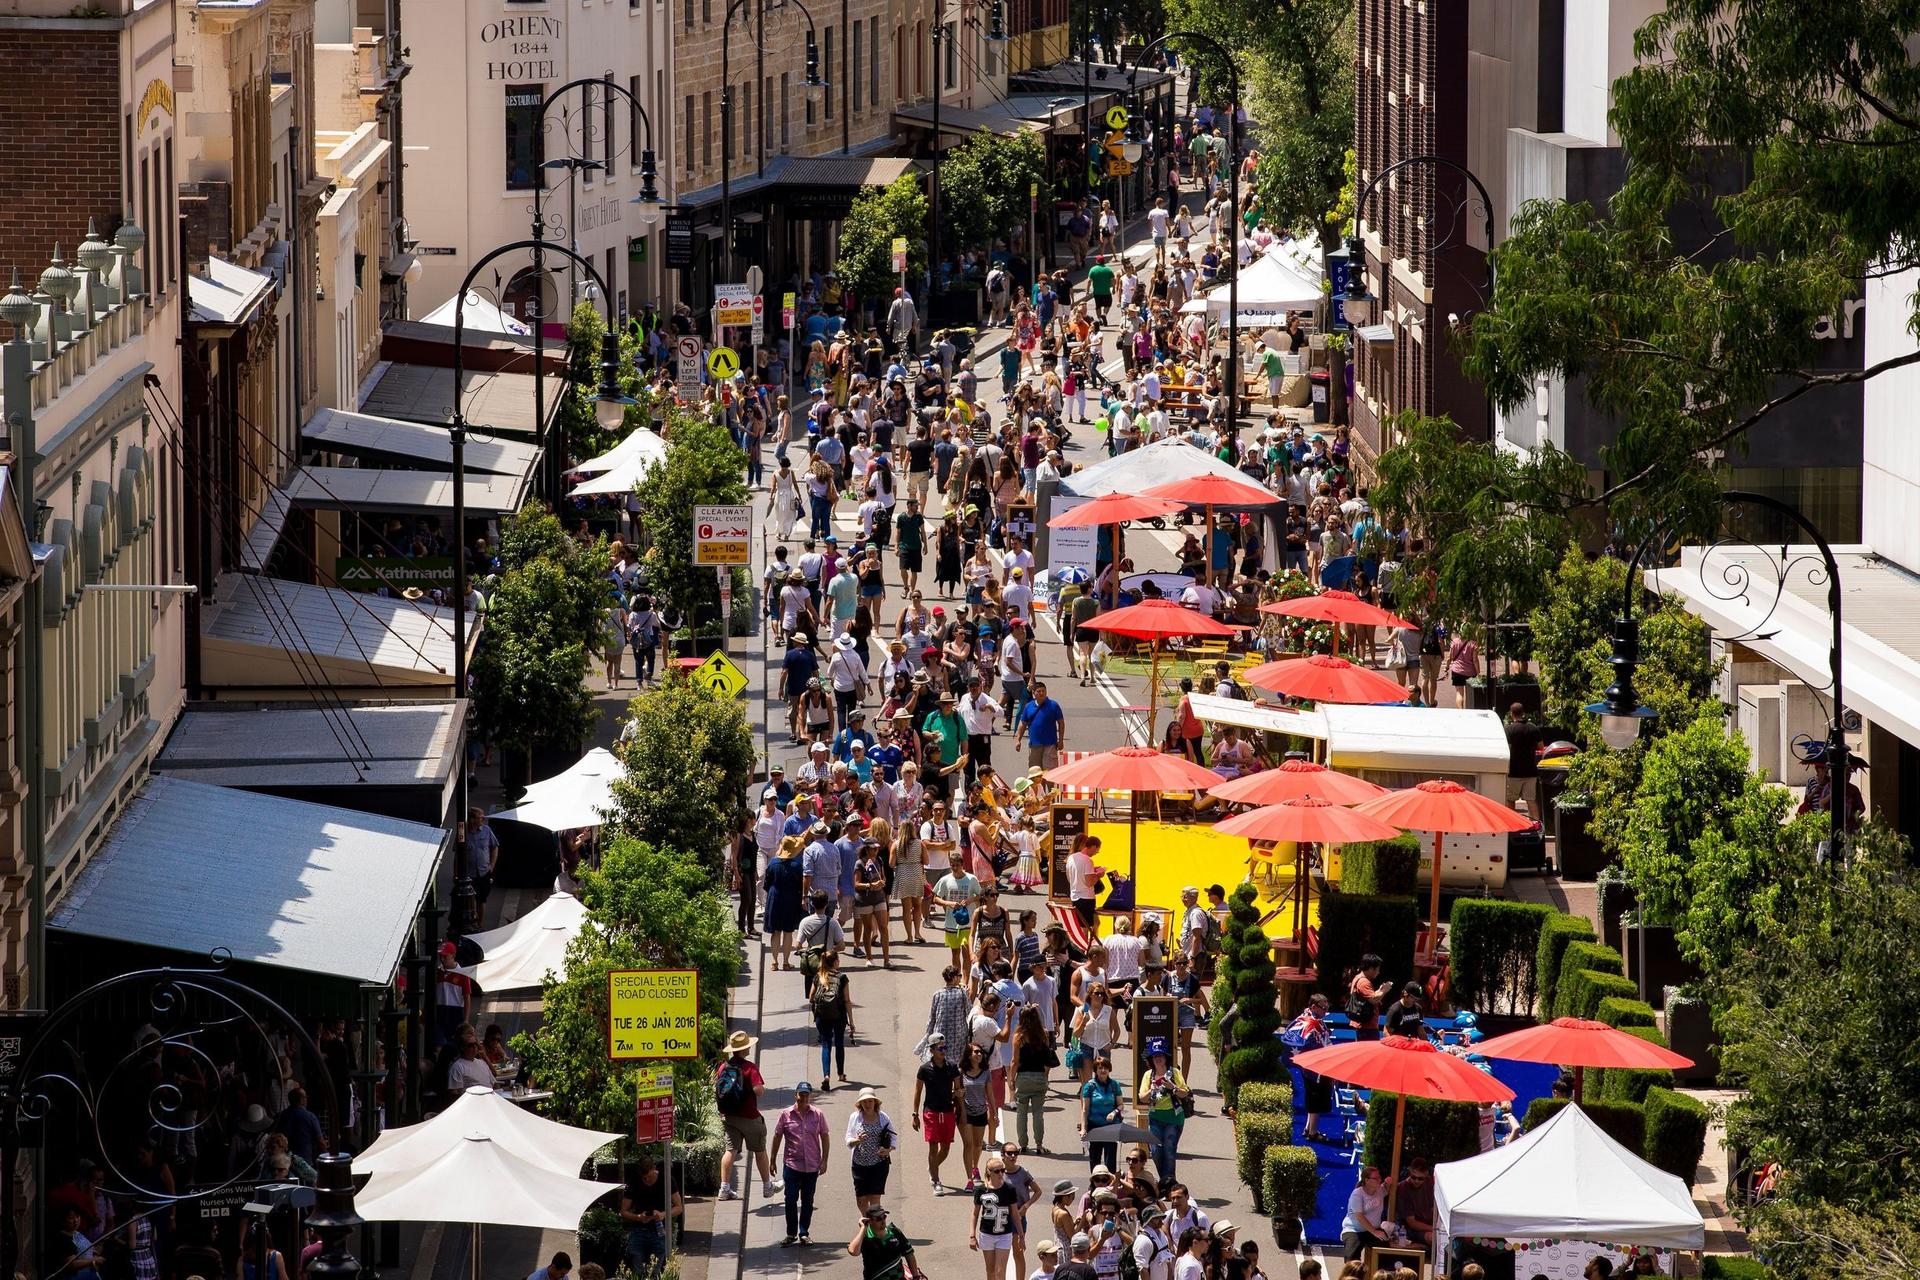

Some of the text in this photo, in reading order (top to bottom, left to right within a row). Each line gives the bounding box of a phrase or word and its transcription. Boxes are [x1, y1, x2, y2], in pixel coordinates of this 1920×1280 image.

[481, 16, 562, 43] ORIENT
[511, 42, 548, 54] 1844
[486, 60, 559, 80] HOTEL
[506, 94, 542, 107] RESTAURANT
[1114, 162, 1128, 170] 25
[578, 196, 622, 233] ORIENT HOTEL
[702, 545, 717, 553] 3AM
[725, 544, 745, 552] 10PM
[614, 976, 691, 987] SPECIAL EVENT
[617, 988, 688, 999] ROAD CLOSED
[614, 1016, 695, 1029] TUE 26 JAN 2016
[615, 1039, 691, 1051] 7AM TO 10PM
[643, 1100, 651, 1108] NO
[662, 1098, 668, 1106] NO
[235, 1184, 255, 1193] Walk
[201, 1197, 246, 1207] Nurses Walk
[980, 1192, 1009, 1233] SF
